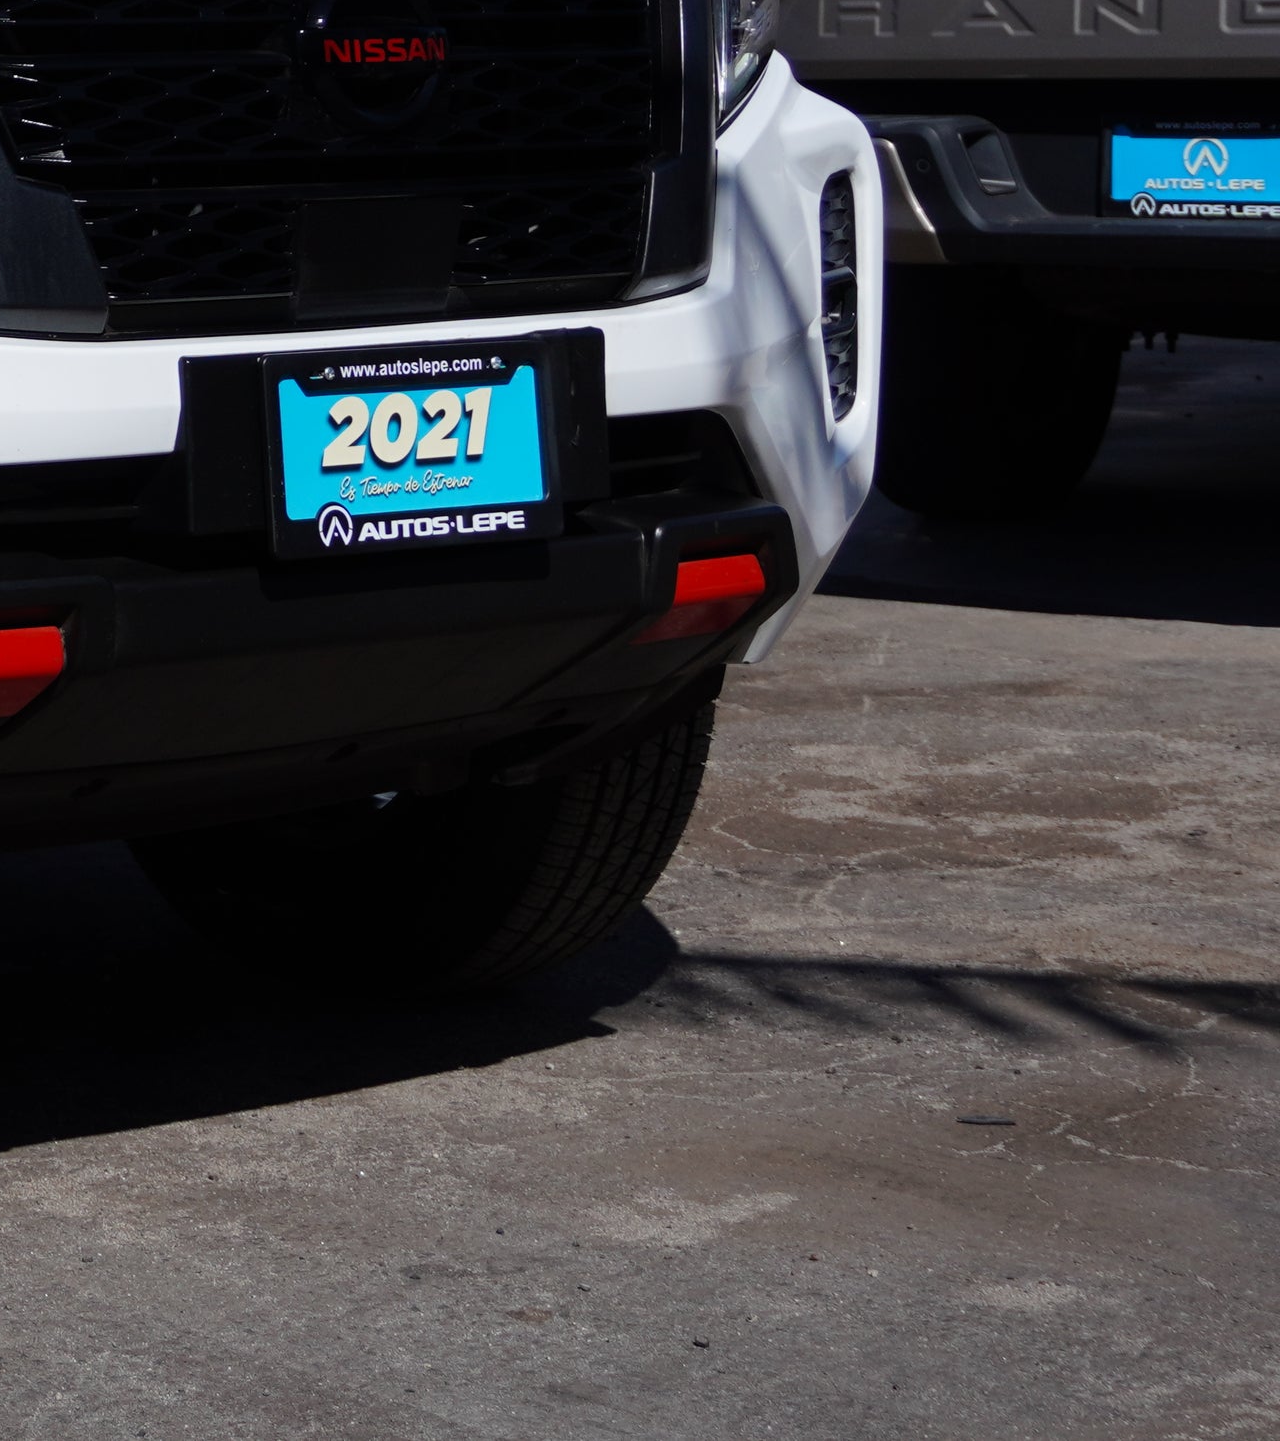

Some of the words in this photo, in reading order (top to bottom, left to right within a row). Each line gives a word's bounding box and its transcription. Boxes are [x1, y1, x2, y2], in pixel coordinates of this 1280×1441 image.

[323, 37, 446, 63] NISSAN
[1155, 120, 1261, 132] www.autoslepe.com
[339, 357, 483, 378] www.autoslepe.com
[322, 387, 494, 468] 2021
[340, 476, 356, 501] Es
[360, 476, 402, 499] Tiempo
[404, 475, 421, 493] de
[422, 469, 474, 495] Estrenar
